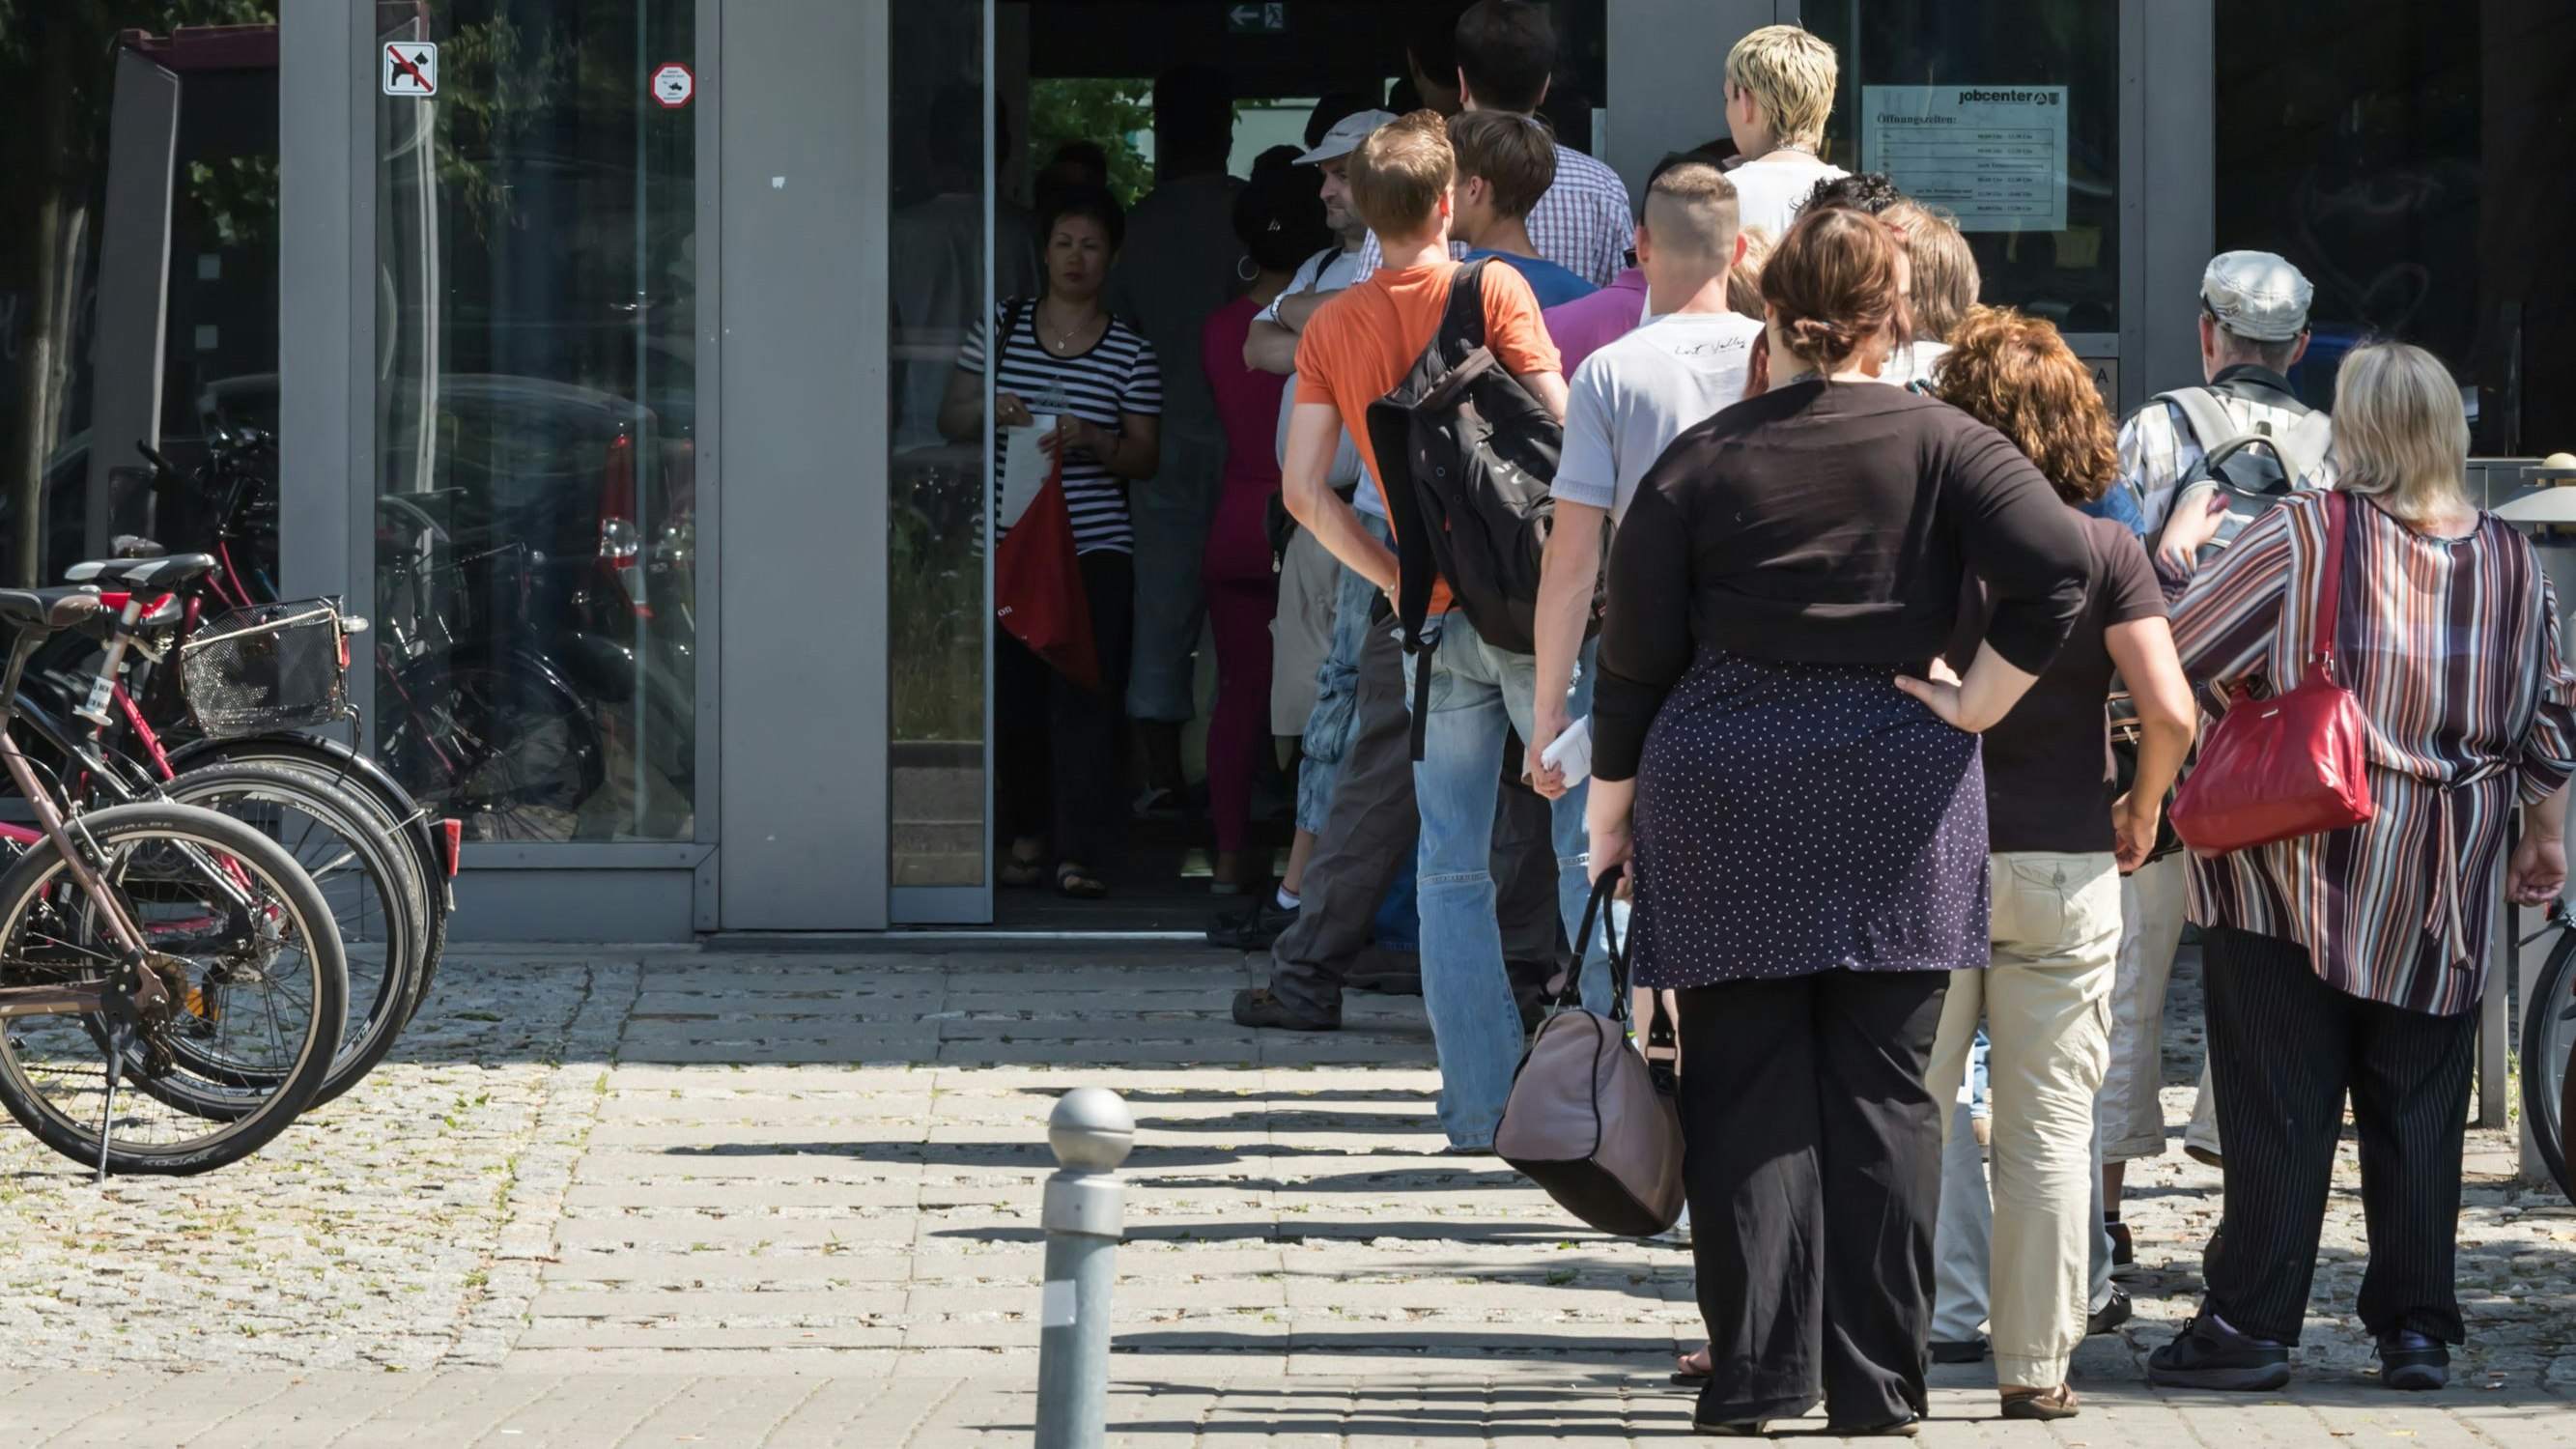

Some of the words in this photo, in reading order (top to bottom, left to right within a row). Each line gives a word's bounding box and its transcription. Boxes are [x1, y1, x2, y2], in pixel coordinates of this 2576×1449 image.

[1959, 89, 2032, 104] jobcenter
[1877, 112, 1957, 126] Öffnungszeiten:
[141, 1153, 210, 1167] KOJAK
